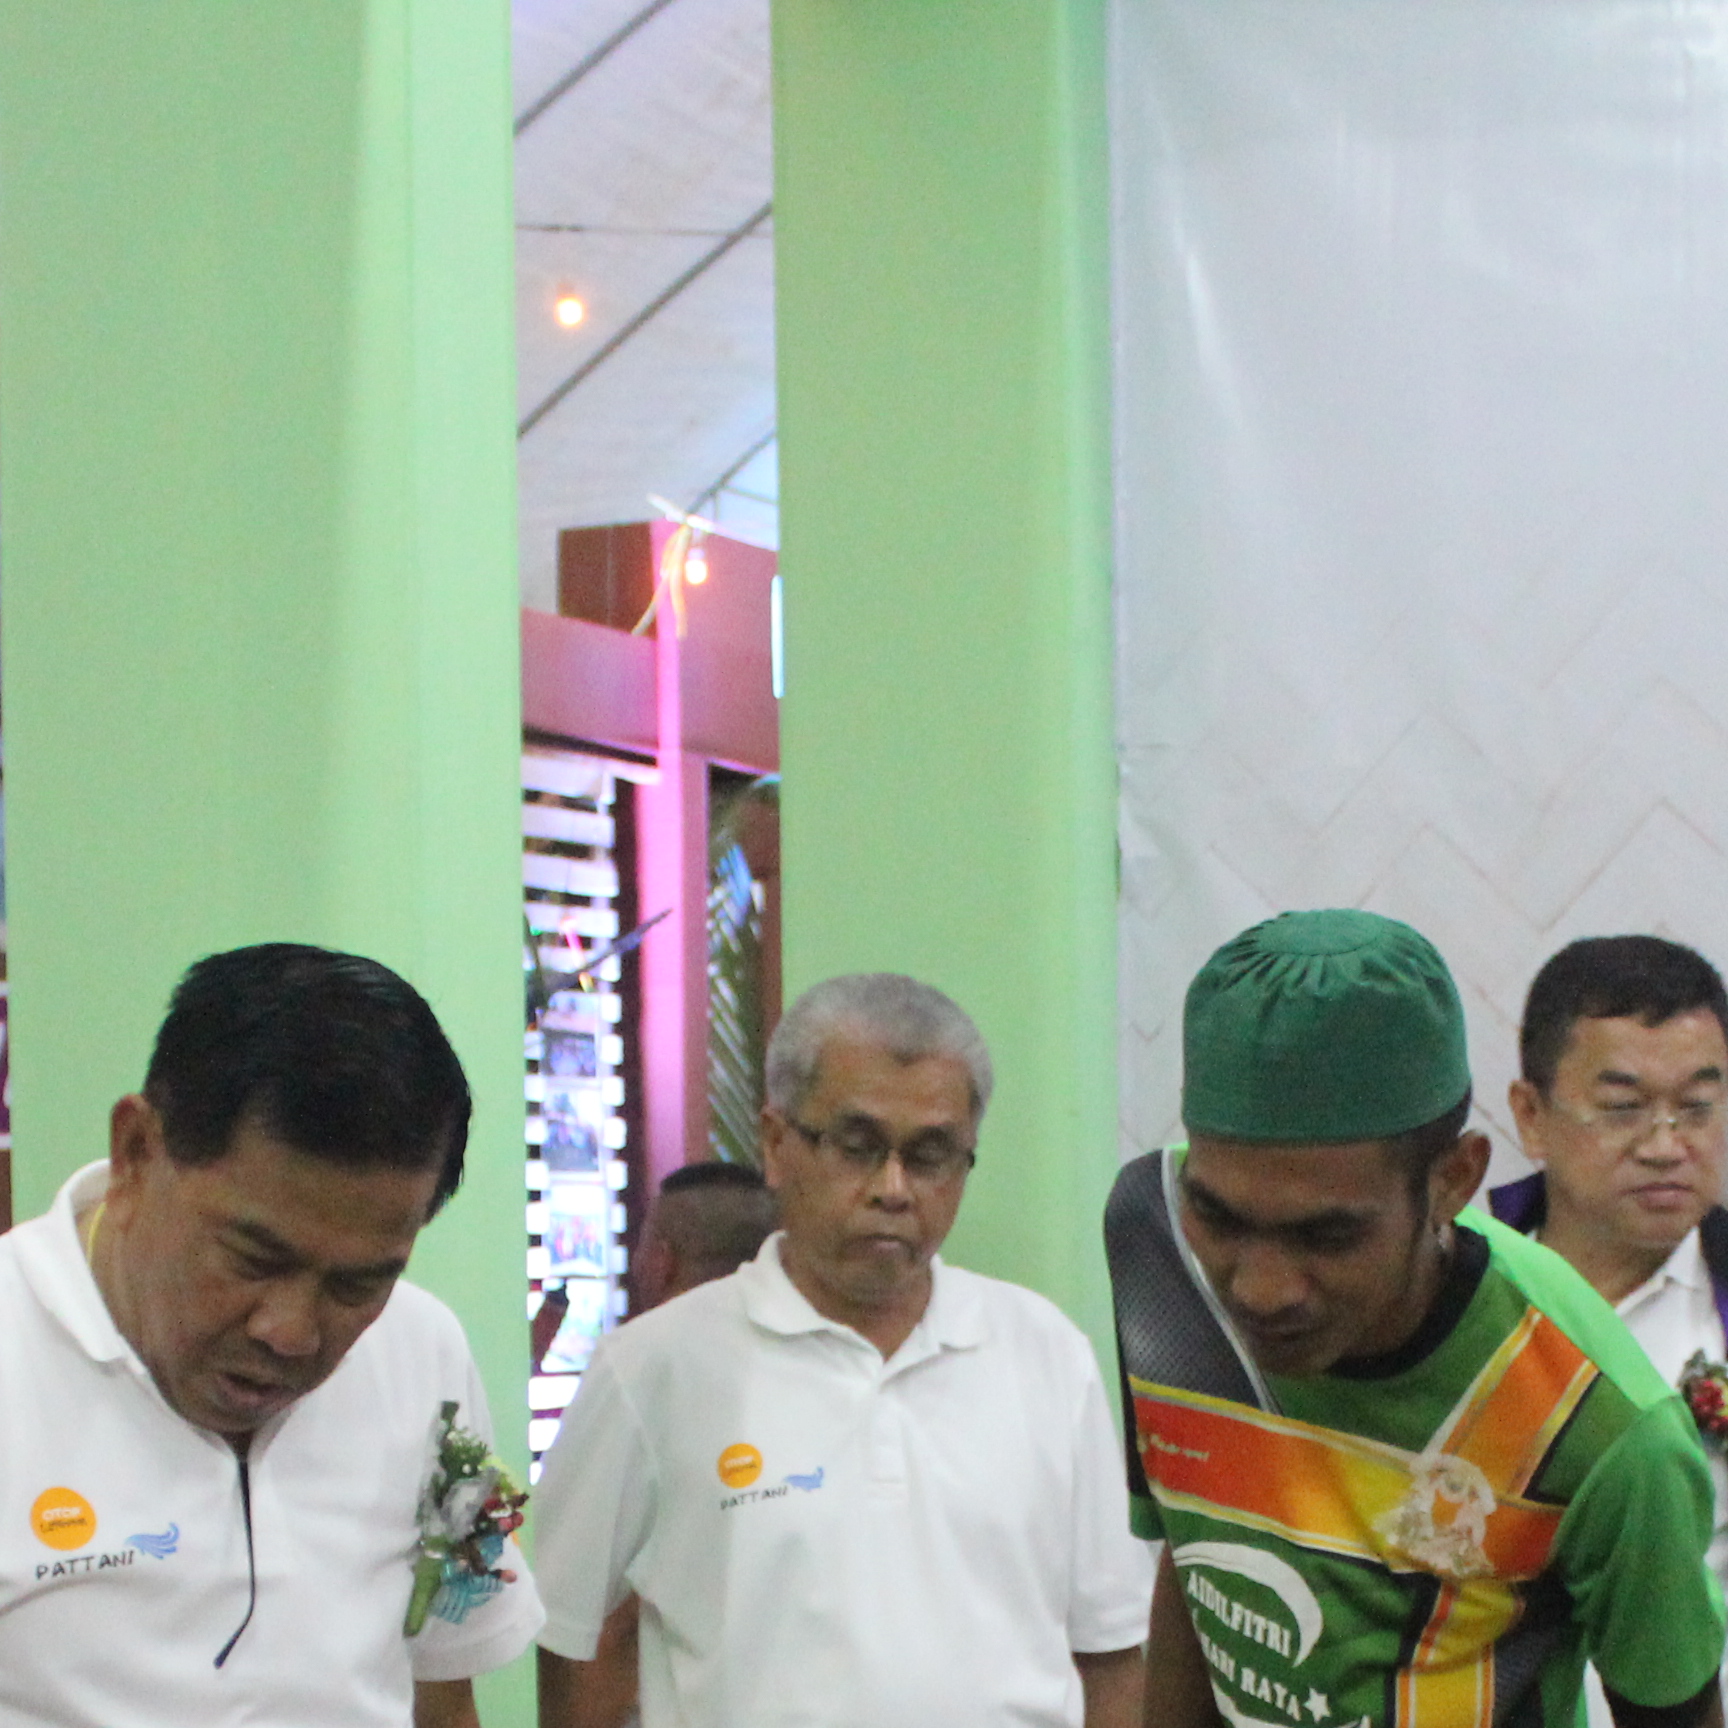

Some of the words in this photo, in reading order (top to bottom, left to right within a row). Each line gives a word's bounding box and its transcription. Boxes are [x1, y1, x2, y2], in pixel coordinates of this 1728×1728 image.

[35, 1550, 134, 1579] PATTANI
[1187, 1570, 1292, 1659] AIDILFITRI
[1240, 1666, 1302, 1722] RAYA
